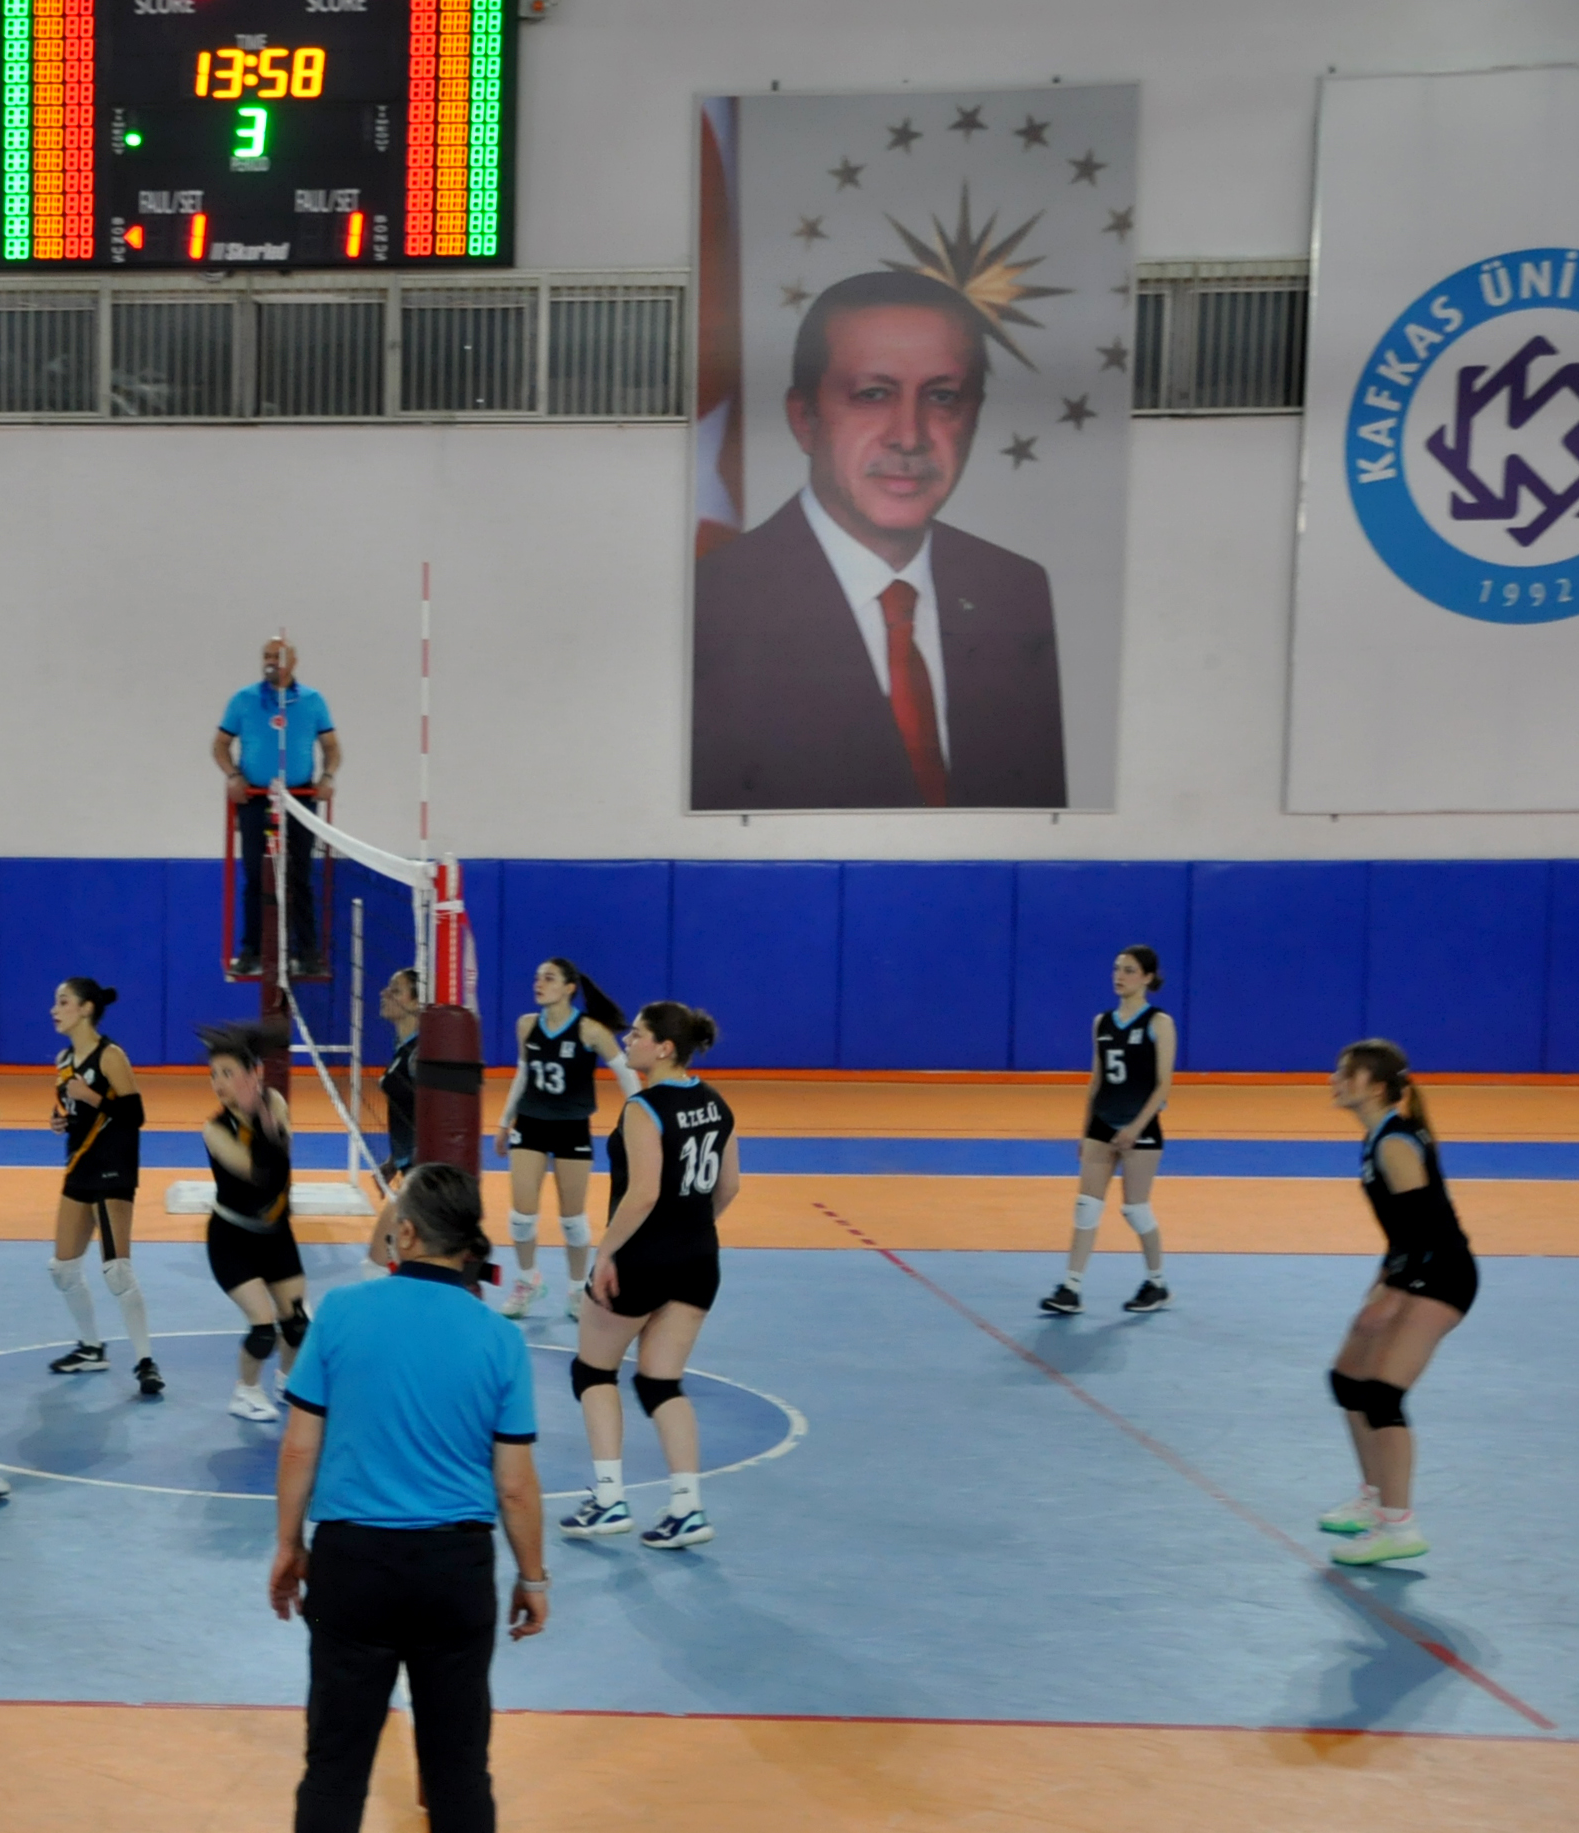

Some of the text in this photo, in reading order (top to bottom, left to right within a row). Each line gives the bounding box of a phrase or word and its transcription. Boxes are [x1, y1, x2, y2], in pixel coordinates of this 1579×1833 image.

[195, 47, 326, 98] 13:58
[233, 106, 268, 157] 3
[188, 213, 208, 260] 1
[345, 212, 365, 259] 1
[1355, 295, 1464, 484] KAFKAS
[1479, 578, 1574, 607] 1992
[530, 1060, 566, 1094] 13
[1106, 1049, 1127, 1085] 5
[679, 1131, 719, 1196] 16
